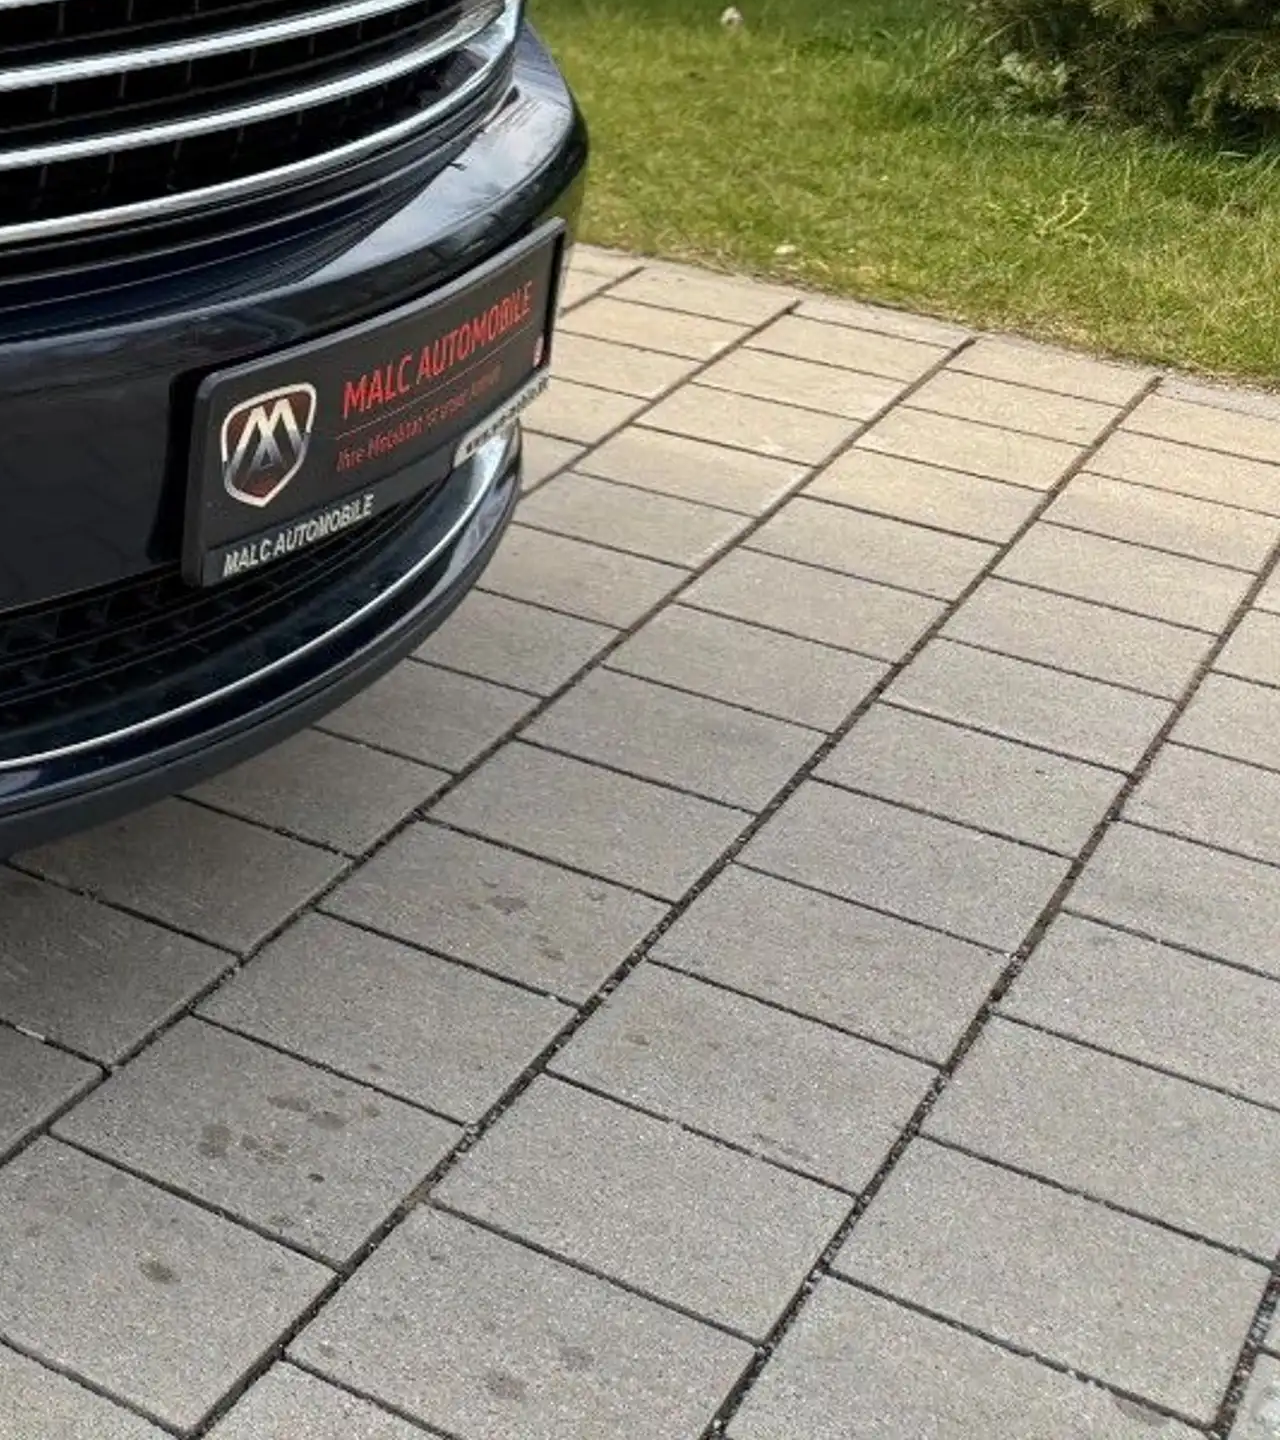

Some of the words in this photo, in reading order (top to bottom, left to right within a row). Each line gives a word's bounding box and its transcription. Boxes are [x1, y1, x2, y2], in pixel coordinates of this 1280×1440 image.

[343, 354, 412, 420] MALC
[415, 280, 533, 385] AUTOMOBILE
[223, 538, 273, 577] MALC
[273, 493, 375, 557] AUTOMOBILE
